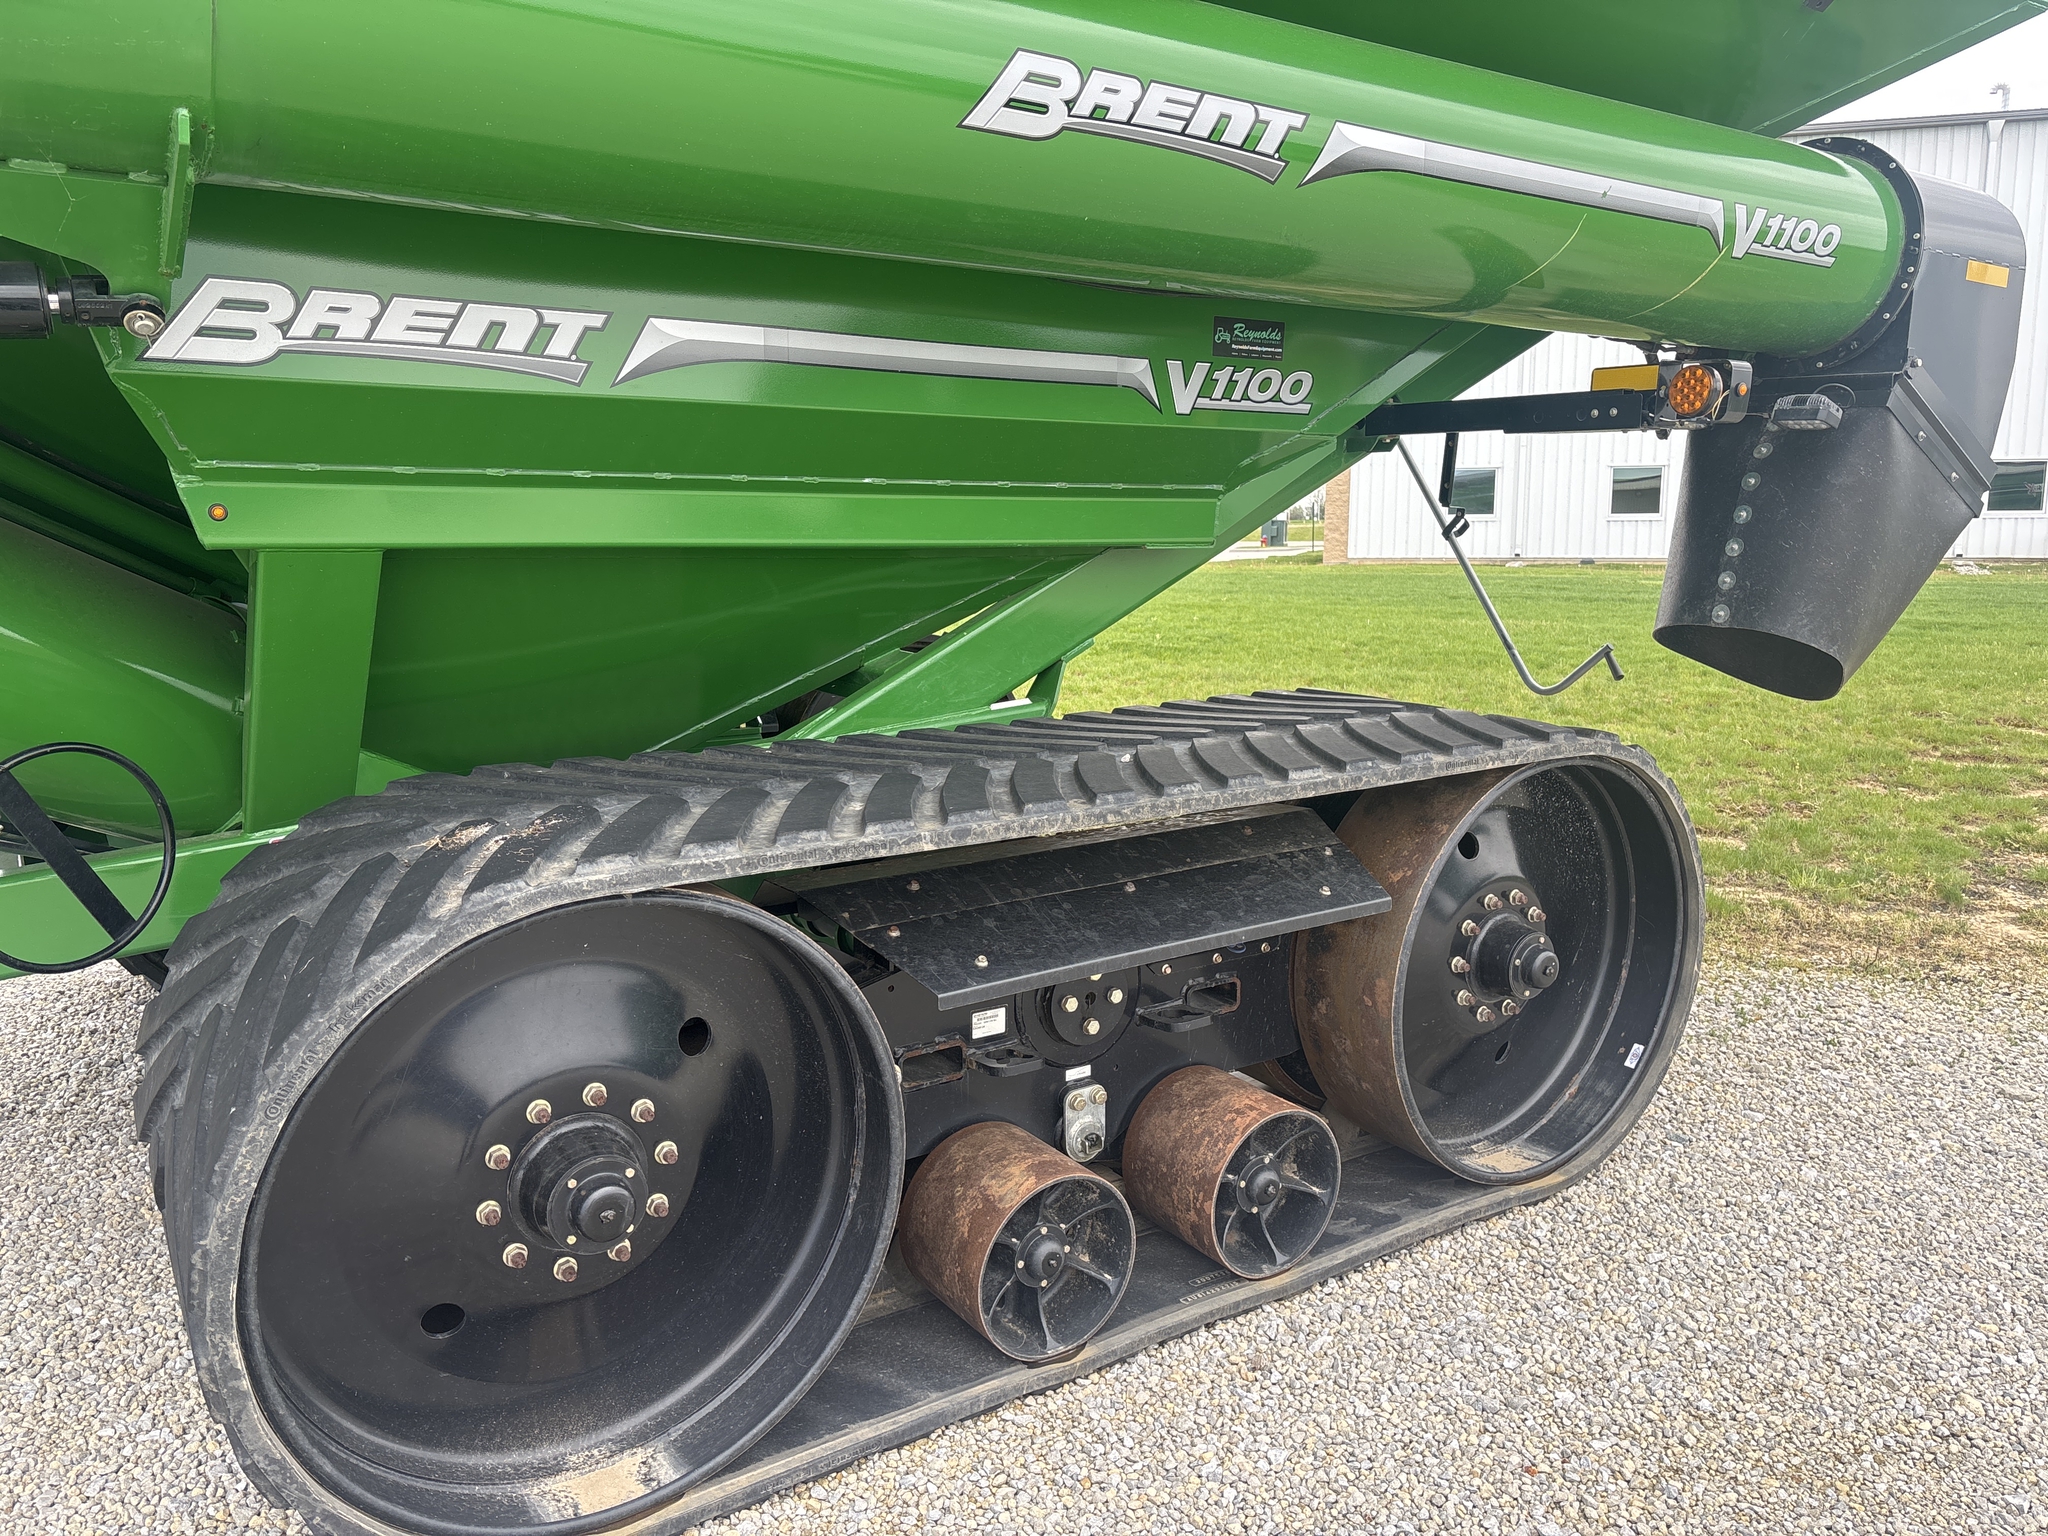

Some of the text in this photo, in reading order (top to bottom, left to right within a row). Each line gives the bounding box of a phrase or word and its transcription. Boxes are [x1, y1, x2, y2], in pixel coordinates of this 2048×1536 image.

[958, 48, 1310, 162] BRENT
[1731, 202, 1842, 260] V1100
[136, 275, 613, 367] BRENT
[1232, 323, 1282, 341] Reynolds
[1165, 359, 1314, 416] V1100
